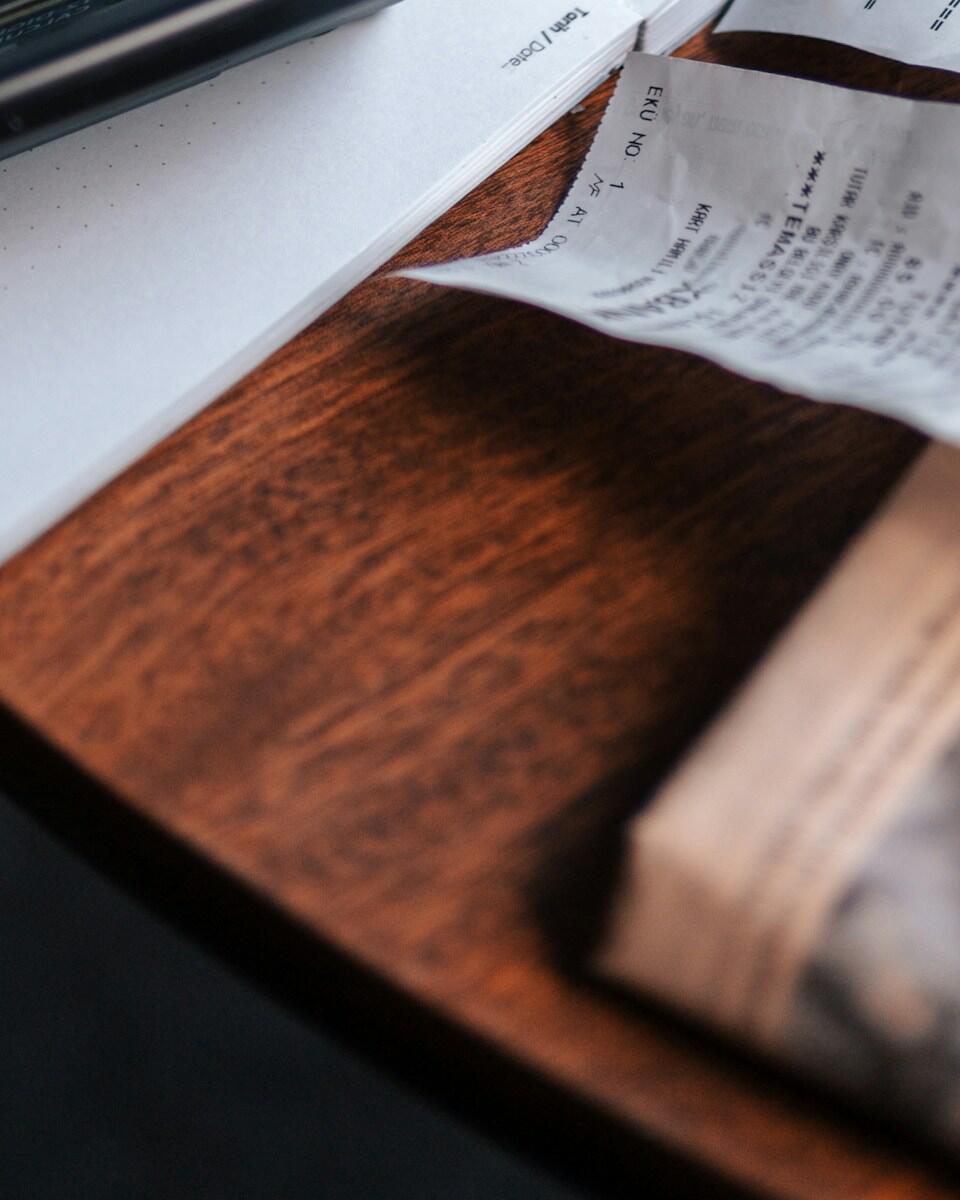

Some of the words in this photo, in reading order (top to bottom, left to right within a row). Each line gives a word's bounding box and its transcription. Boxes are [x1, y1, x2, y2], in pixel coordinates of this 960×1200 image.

[550, 7, 590, 34] Tarih
[541, 30, 553, 45] /
[609, 181, 625, 190] 1
[567, 206, 588, 227] AT
[685, 202, 713, 234] KART
